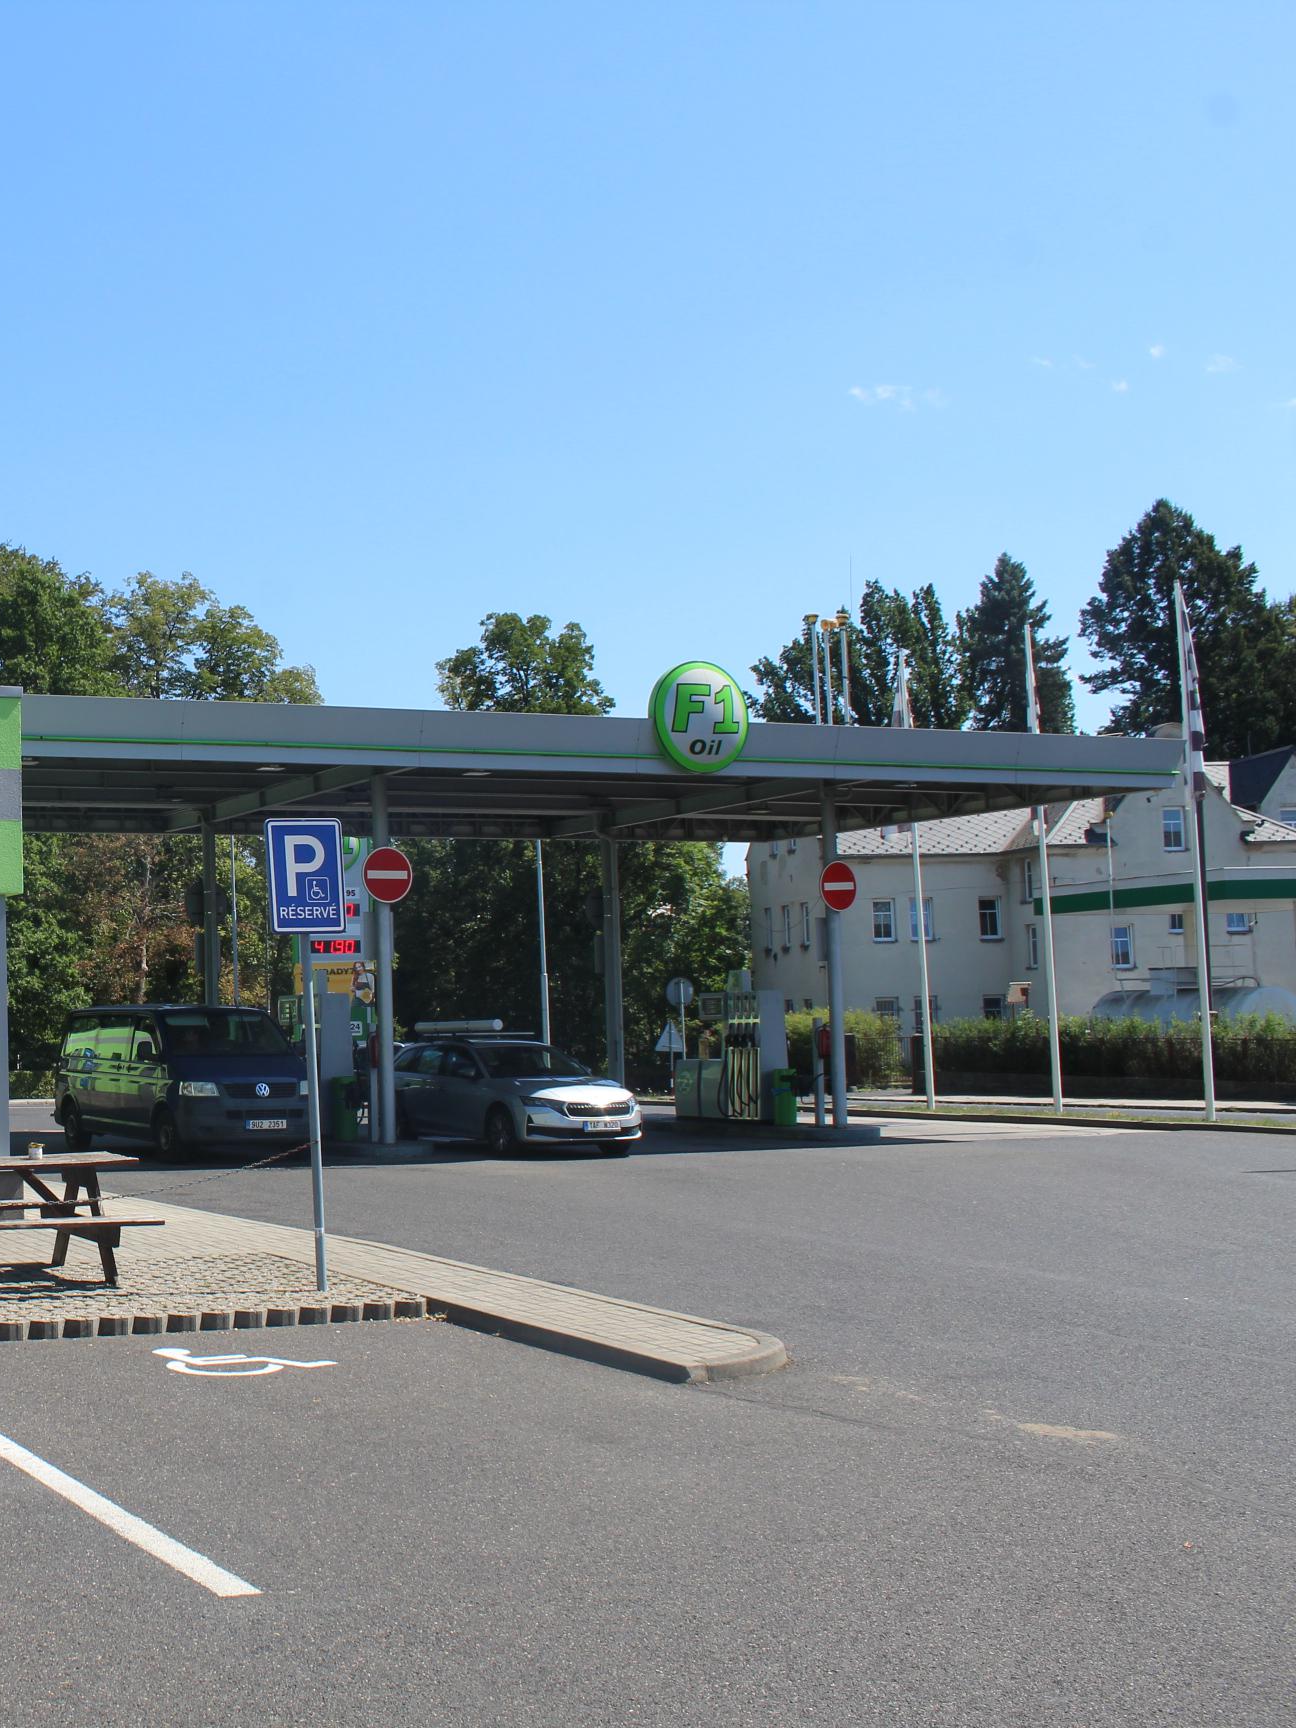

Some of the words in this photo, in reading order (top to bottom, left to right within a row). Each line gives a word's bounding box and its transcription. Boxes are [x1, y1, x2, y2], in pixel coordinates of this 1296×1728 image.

[671, 683, 739, 734] F1
[689, 739, 722, 755] Oil
[284, 835, 324, 897] P
[280, 903, 337, 919] RÉSERVÉ
